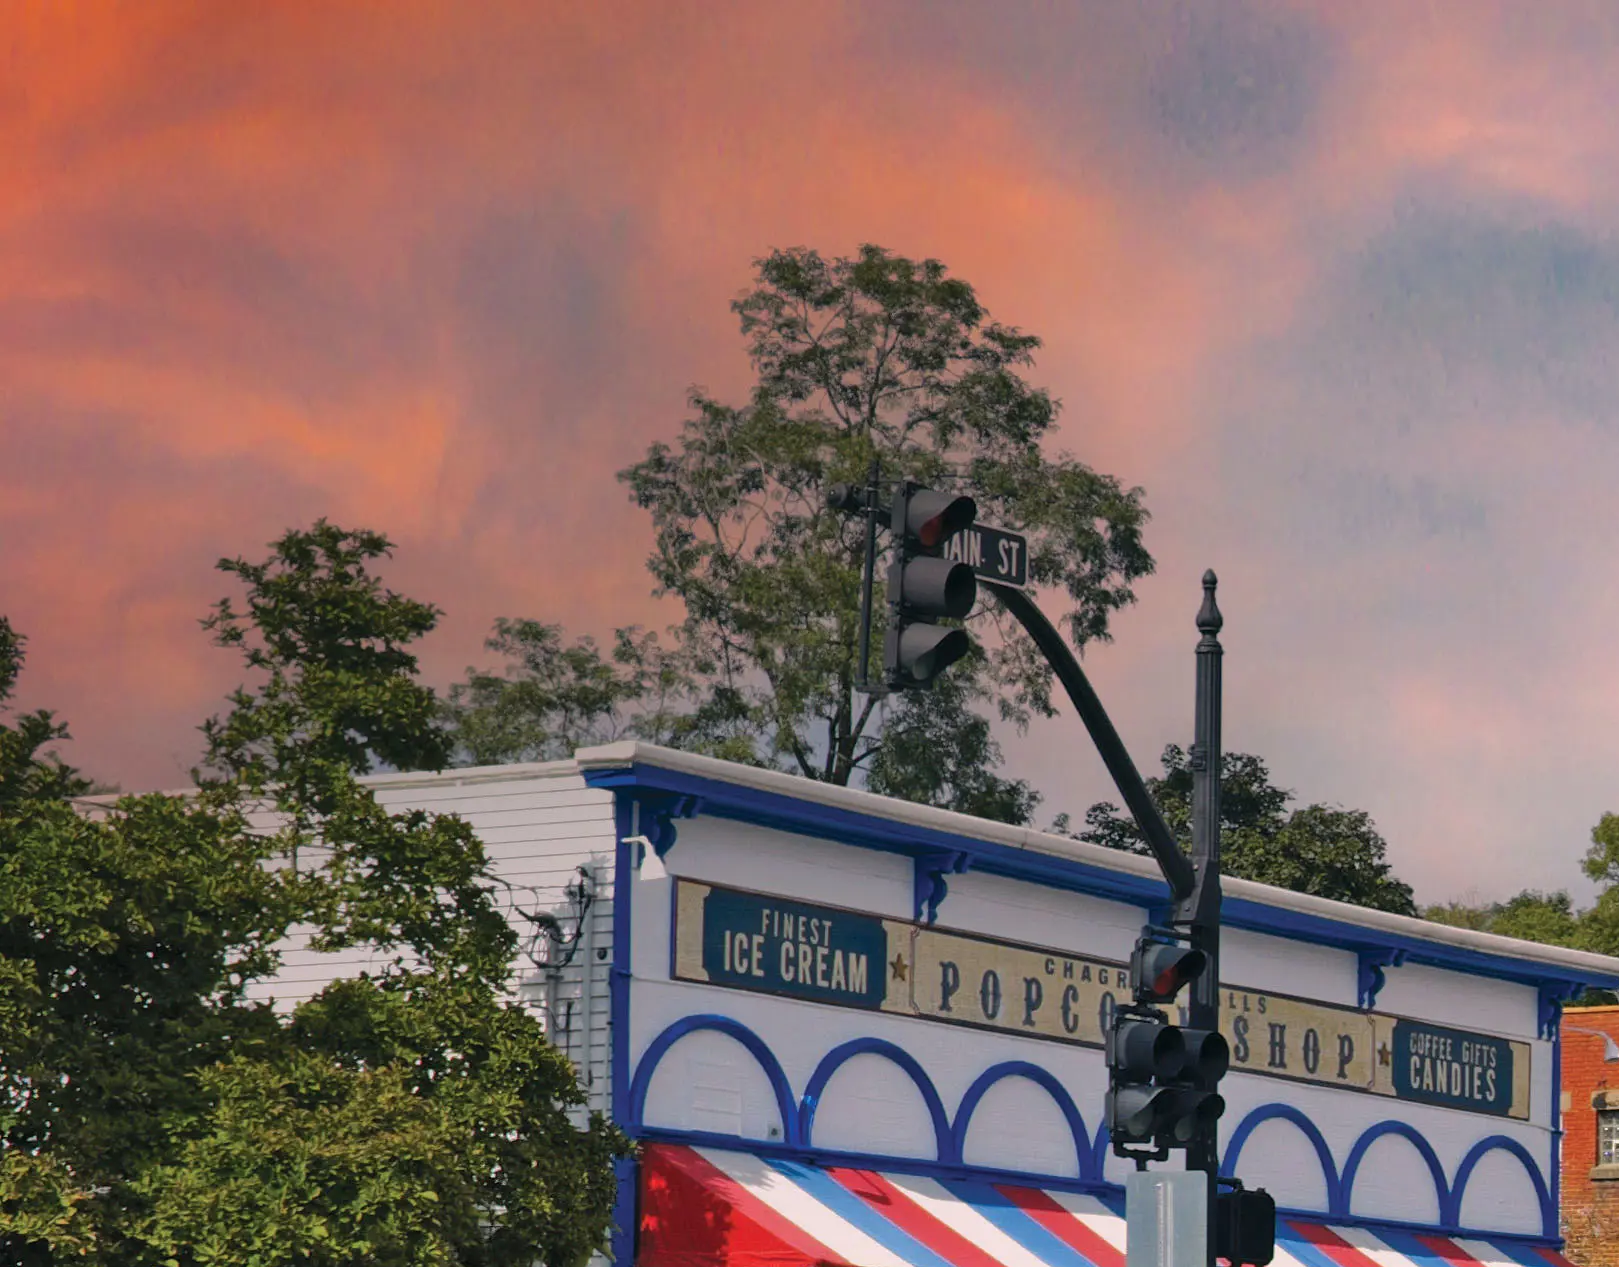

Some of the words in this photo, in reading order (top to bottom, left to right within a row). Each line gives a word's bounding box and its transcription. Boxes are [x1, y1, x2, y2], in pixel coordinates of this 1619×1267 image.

[998, 538, 1020, 577] ST
[762, 909, 832, 946] FINEST
[724, 930, 765, 977] ICE
[780, 941, 868, 994] CREAM
[1044, 958, 1131, 989] CHAGR
[1228, 992, 1267, 1014] LLS
[938, 960, 1190, 1042] POPCO
[1233, 1015, 1355, 1080] SHOP
[1409, 1032, 1452, 1061] COFFEE
[1462, 1041, 1497, 1068] GIFTS
[1410, 1055, 1496, 1102] CANDIES
